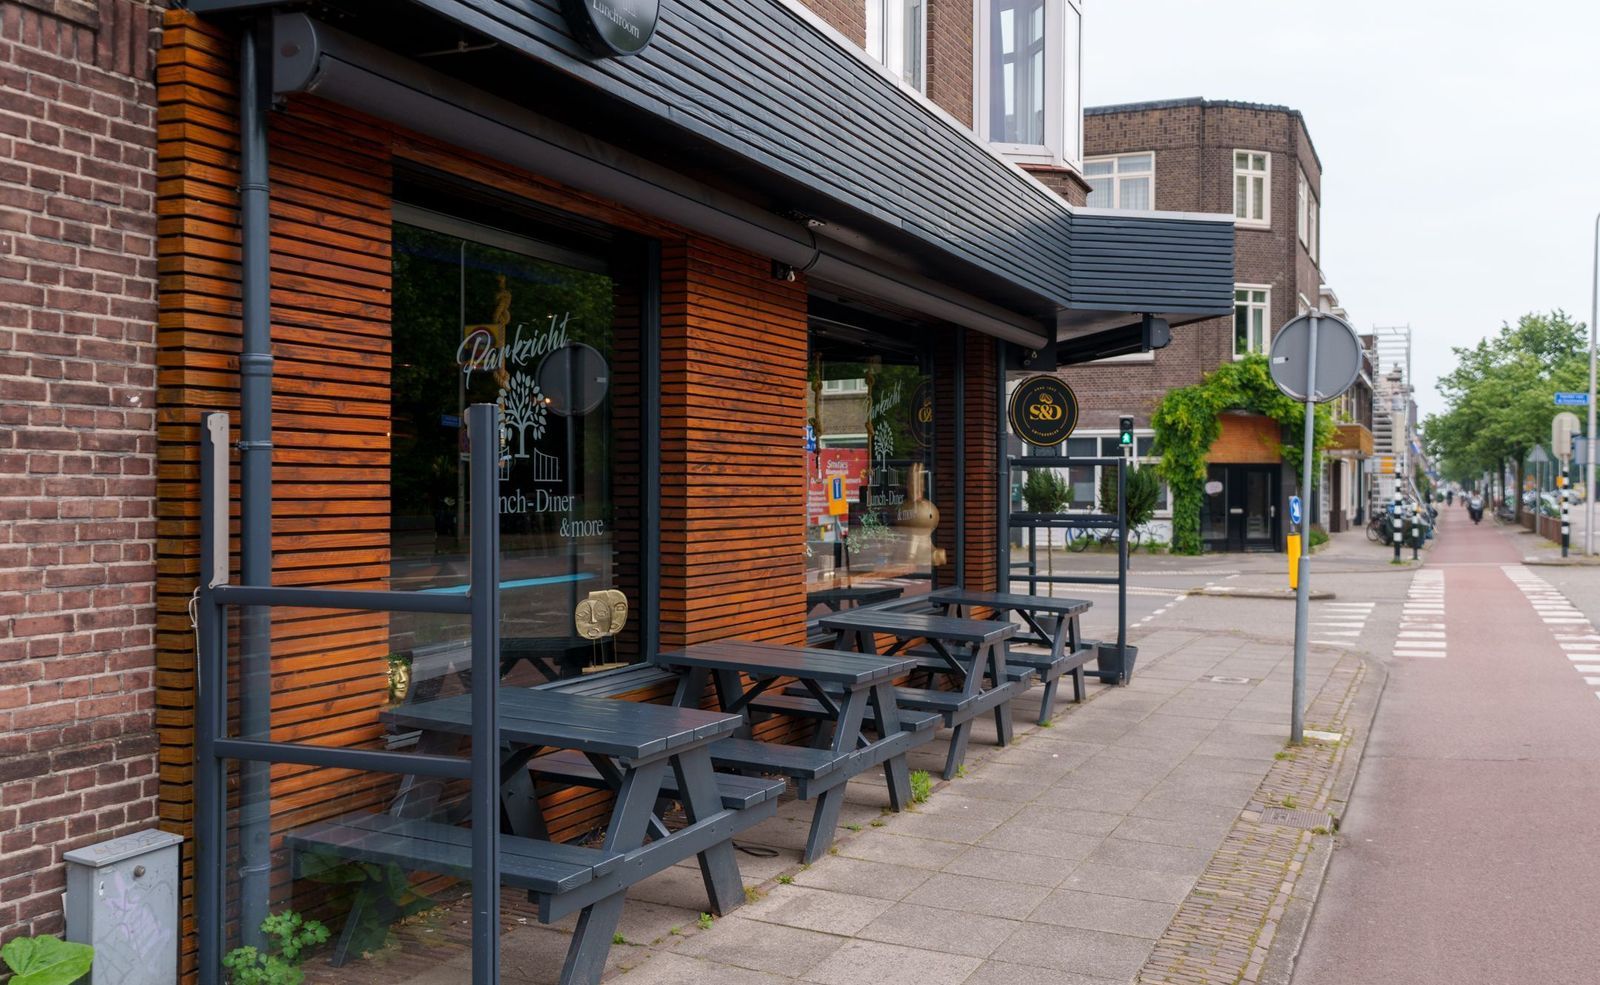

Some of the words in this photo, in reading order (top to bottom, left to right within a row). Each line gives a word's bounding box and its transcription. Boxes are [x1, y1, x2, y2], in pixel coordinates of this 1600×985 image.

[592, 0, 640, 39] Lunchroom
[456, 311, 579, 390] Parkzicht
[1029, 404, 1063, 420] S&D
[498, 488, 576, 514] nch-Diner
[559, 516, 605, 538] &more
